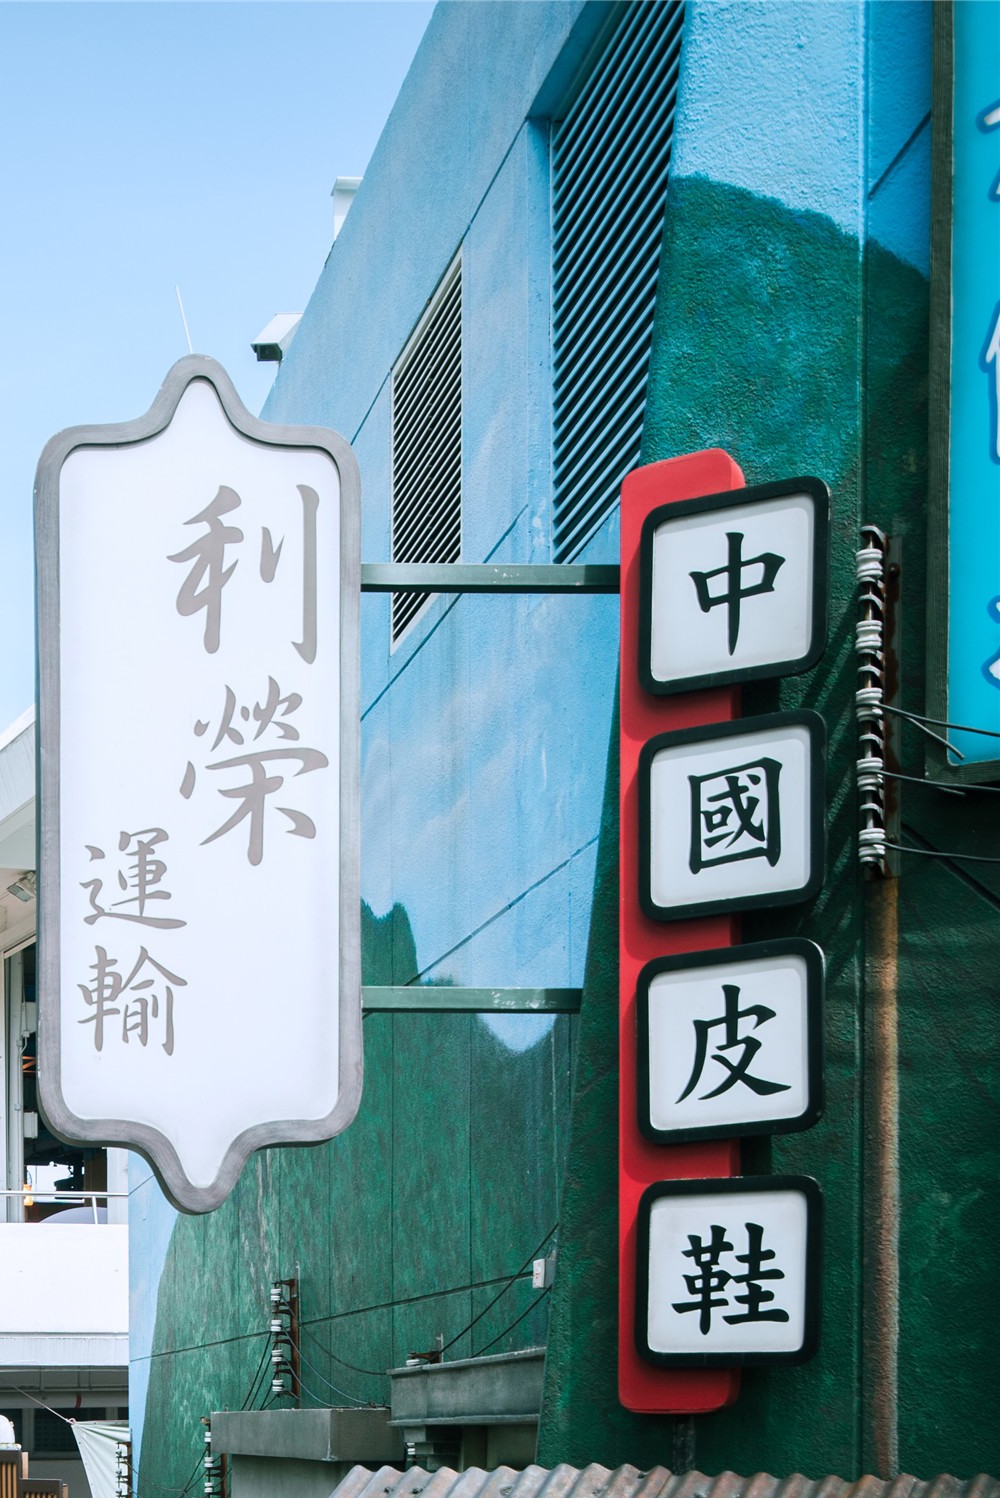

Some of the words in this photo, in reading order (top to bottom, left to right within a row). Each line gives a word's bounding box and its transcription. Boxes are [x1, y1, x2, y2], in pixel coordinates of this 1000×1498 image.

[166, 484, 329, 867] 利榮
[76, 827, 188, 1057] 運輸
[672, 531, 792, 1336] 中國皮鞋
